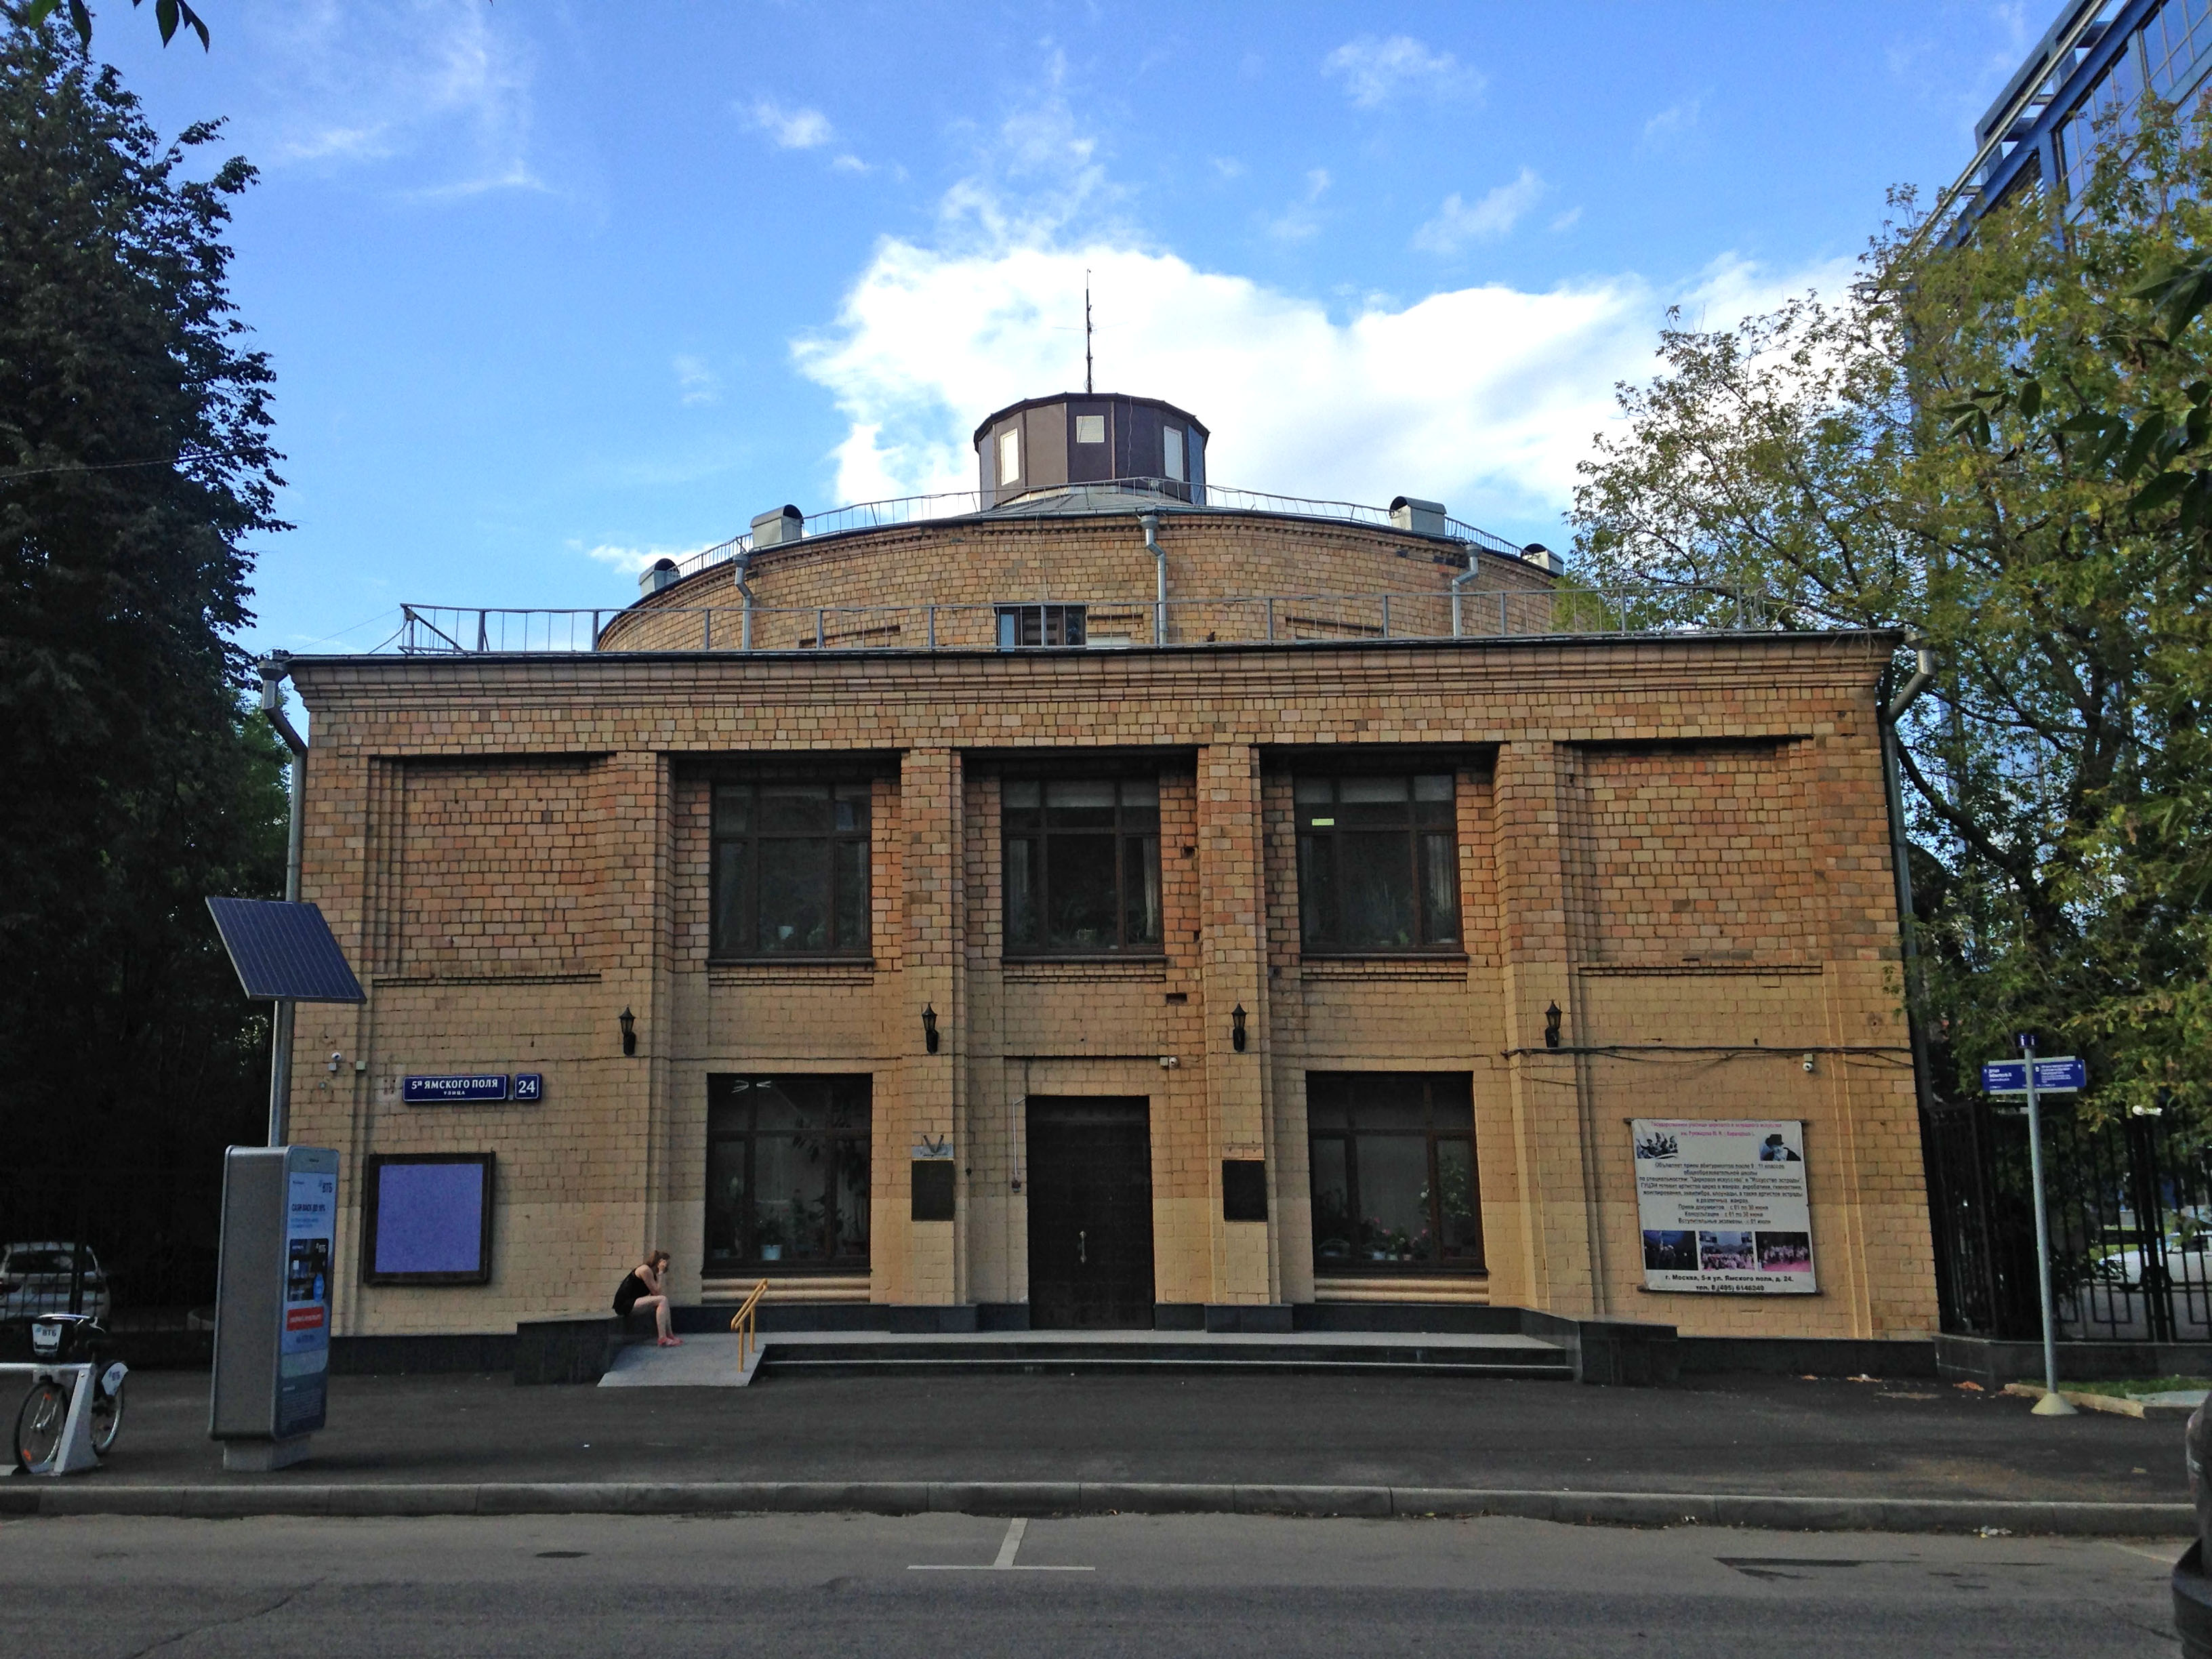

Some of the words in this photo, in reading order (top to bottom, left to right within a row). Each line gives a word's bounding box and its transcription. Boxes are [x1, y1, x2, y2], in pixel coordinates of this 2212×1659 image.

[424, 1080, 470, 1089] ЯМСКОГО
[472, 1079, 498, 1088] ПОЛЯ
[518, 1080, 535, 1094] 24
